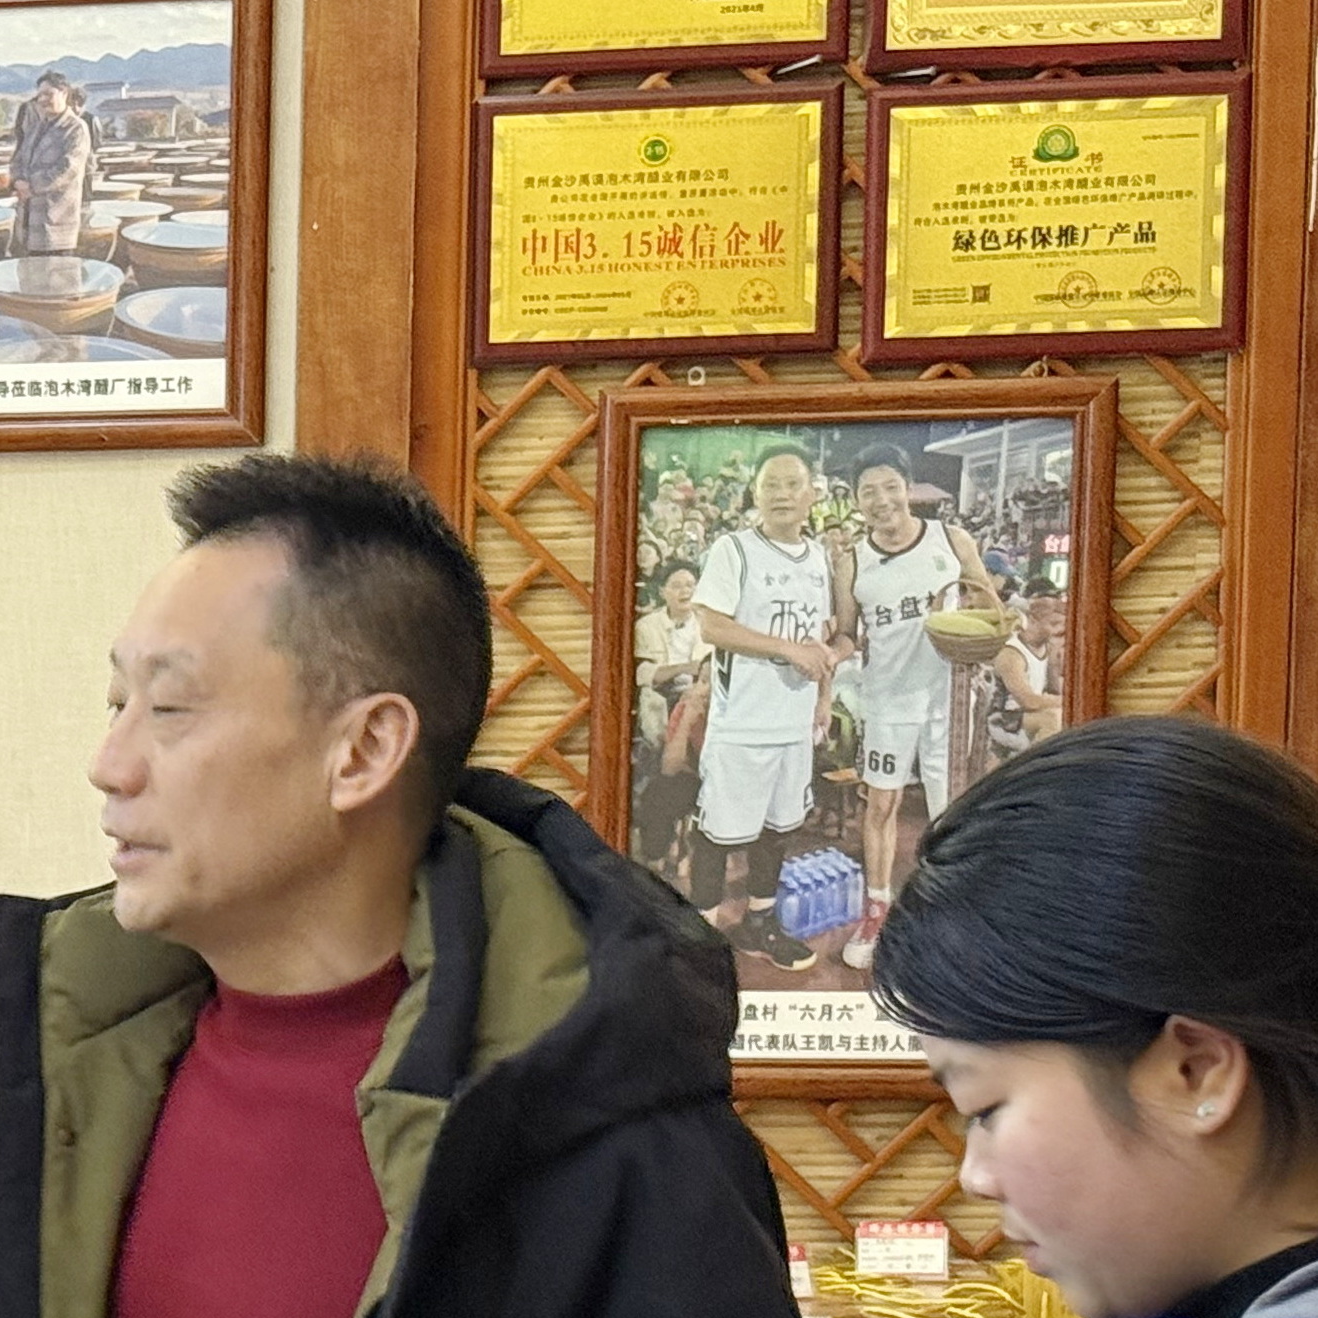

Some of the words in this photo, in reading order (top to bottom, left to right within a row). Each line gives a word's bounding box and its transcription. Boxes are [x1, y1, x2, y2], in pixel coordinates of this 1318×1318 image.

[950, 220, 1157, 253] 绿色环保推广产品
[521, 264, 573, 278] CHINA
[607, 259, 673, 275] HONEST
[676, 256, 787, 272] ENTERPRISES
[868, 751, 896, 775] 66
